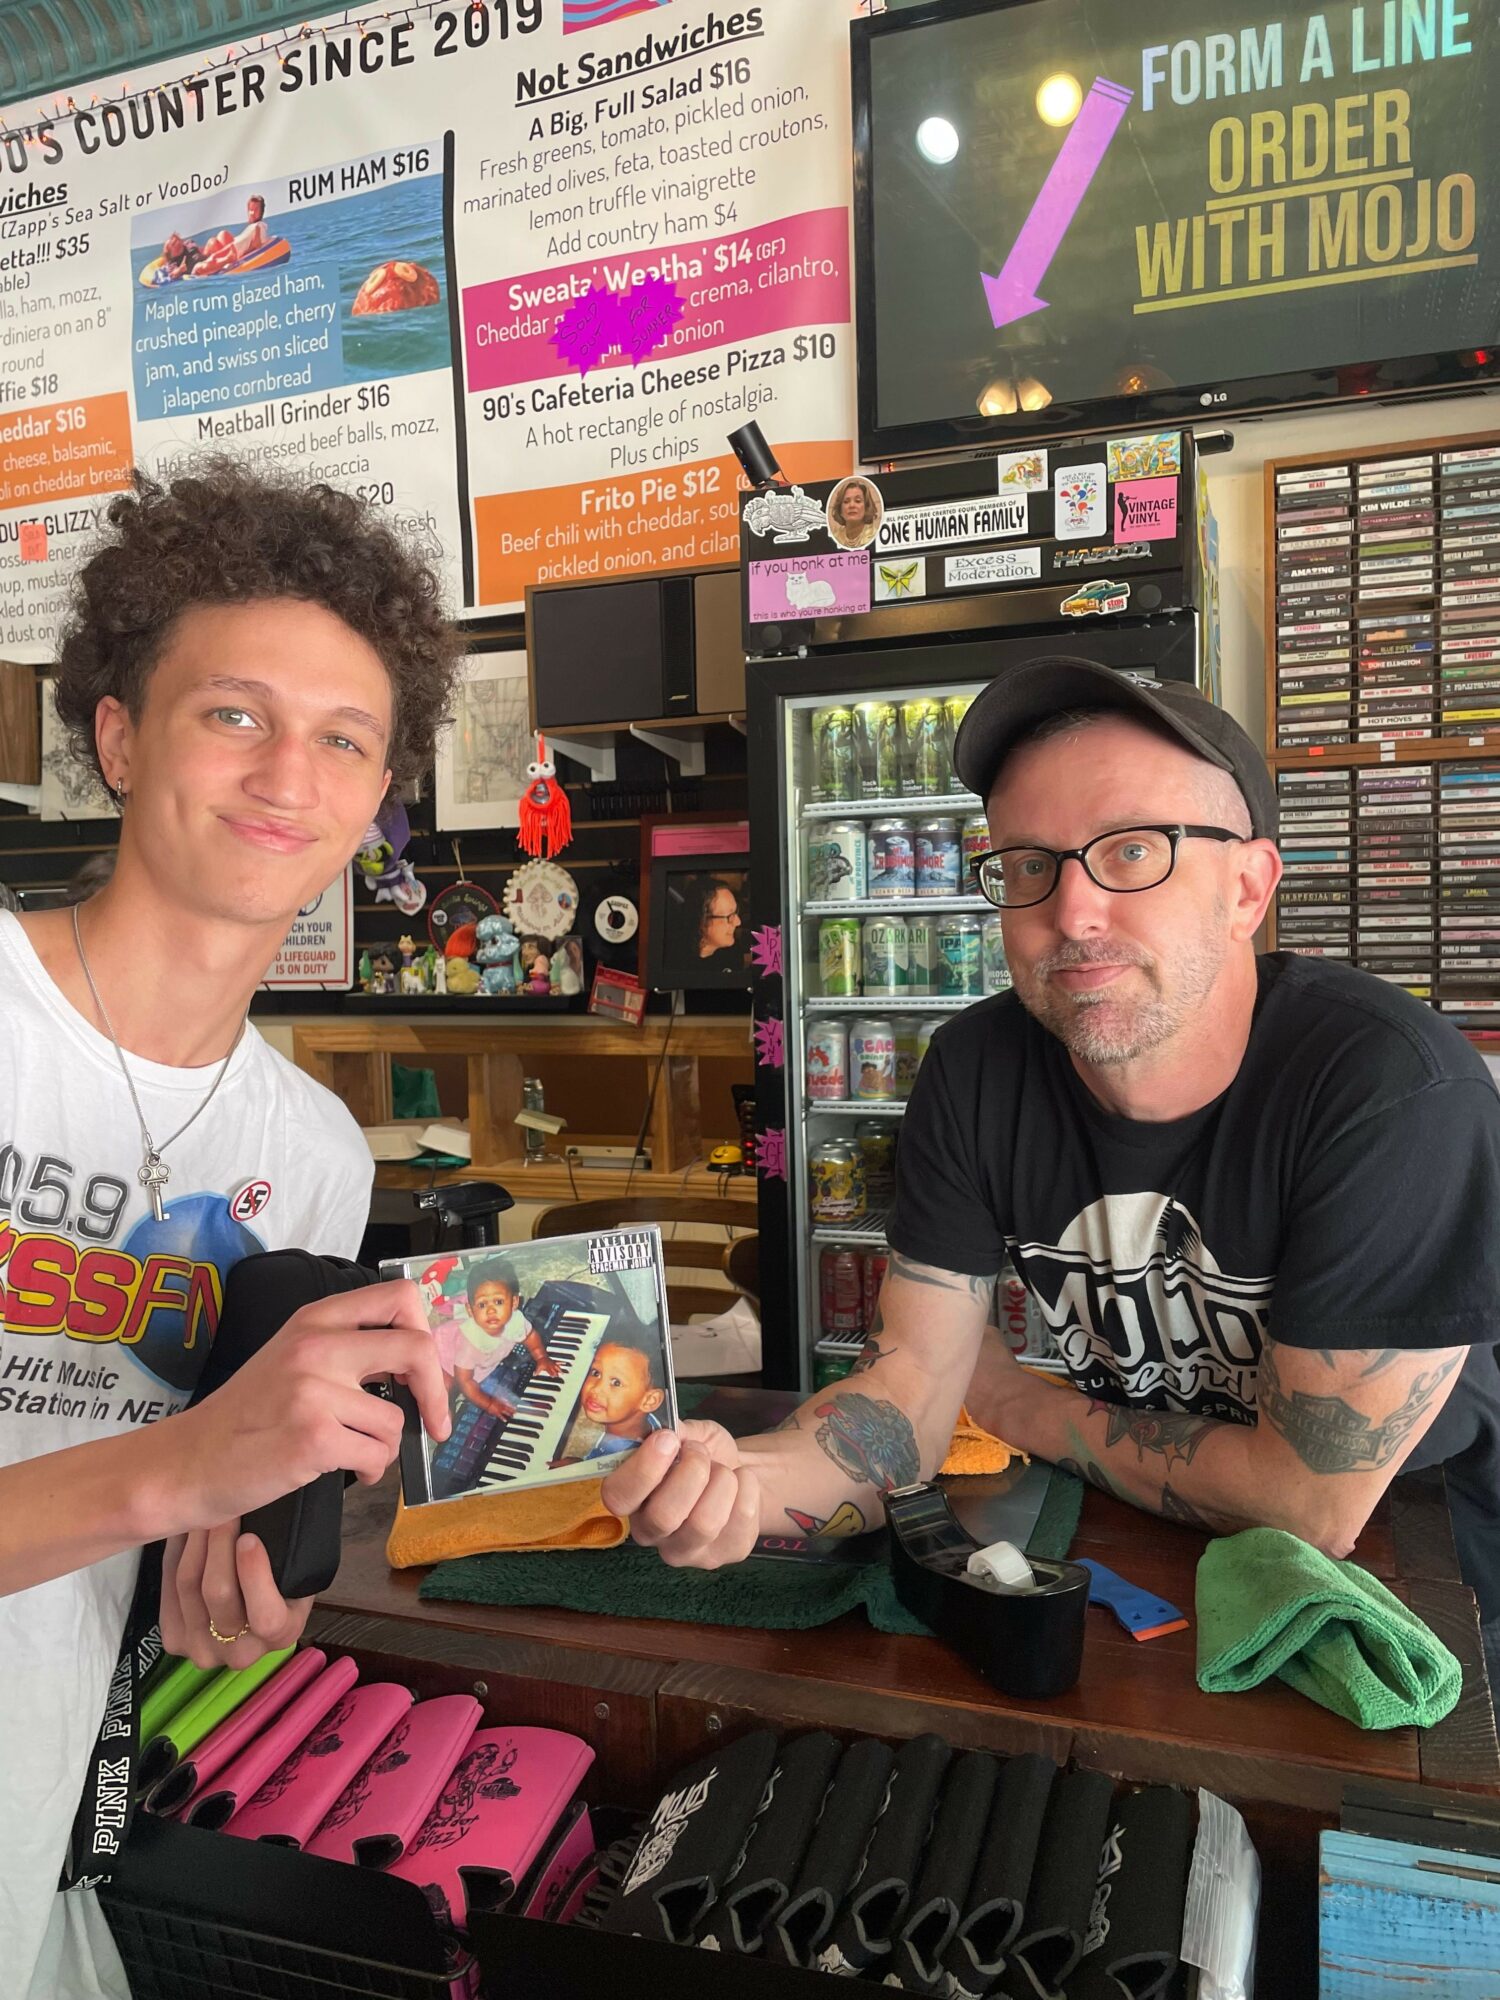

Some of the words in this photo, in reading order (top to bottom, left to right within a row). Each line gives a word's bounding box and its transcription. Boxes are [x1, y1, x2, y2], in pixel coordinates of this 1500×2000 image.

[516, 63, 570, 101] Not
[577, 7, 764, 84] Sandwiches
[1142, 23, 1283, 112] FORM
[1300, 14, 1335, 83] A
[1352, 0, 1473, 74] LINE
[74, 64, 265, 155] COUNTER
[280, 22, 415, 92] SINCE
[434, 0, 542, 57] 2019
[529, 117, 544, 141] A
[551, 109, 589, 136] Big,
[595, 89, 635, 123] Full
[641, 67, 702, 109] Salad
[709, 57, 751, 90] $16
[480, 150, 528, 180] Fresh
[533, 139, 596, 174] greens,
[602, 115, 669, 149] tomato,
[675, 90, 745, 136] pickled
[751, 83, 810, 114] onion,
[1209, 88, 1411, 194] ORDER
[289, 172, 334, 203] RUM
[341, 158, 386, 192] HAM
[392, 148, 430, 178] $16
[463, 174, 552, 214] marinated
[556, 164, 611, 193] olives,
[614, 151, 655, 178] feta,
[659, 130, 732, 166] toasted
[739, 112, 830, 150] croutons,
[1, 211, 59, 239] (Zapp's
[65, 207, 93, 225] Sea
[99, 194, 130, 216] Salt
[136, 193, 152, 207] or
[158, 165, 229, 201] VooDoo)
[529, 203, 583, 230] lemon
[589, 184, 647, 217] truffle
[651, 164, 757, 202] vinaigrette
[55, 233, 90, 259] $35
[547, 231, 582, 259] Add
[587, 217, 659, 251] country
[664, 209, 709, 236] ham
[714, 201, 739, 227] $4
[1135, 202, 1285, 298] WITH
[1308, 172, 1476, 272] MOJO
[508, 266, 598, 311] Sweata'
[714, 238, 753, 272] $14
[756, 237, 786, 262] (GF)
[690, 277, 753, 308] crema,
[758, 258, 840, 290] cilantro,
[145, 296, 188, 323] Maple
[192, 295, 228, 312] rum
[232, 276, 280, 312] glazed
[285, 273, 325, 295] ham,
[135, 323, 198, 353] crushed
[203, 310, 282, 347] pineapple,
[285, 301, 336, 326] cherry
[476, 309, 550, 347] Cheddar
[673, 317, 724, 346] onion
[2, 348, 44, 373] round
[145, 362, 179, 387] jam,
[183, 351, 213, 376] and
[218, 348, 257, 371] swiss
[262, 345, 280, 361] on
[284, 328, 329, 357] sliced
[483, 392, 526, 421] 90's
[531, 377, 635, 413] Cafeteria
[641, 364, 720, 396] Cheese
[726, 346, 786, 377] Pizza
[792, 332, 836, 362] $10
[31, 373, 58, 397] $18
[162, 386, 230, 415] jalapeno
[234, 363, 312, 397] cornbread
[56, 406, 86, 433] $16
[198, 403, 275, 440] Meatball
[281, 392, 351, 425] Grinder
[357, 384, 390, 411] $16
[525, 426, 538, 448] A
[543, 421, 574, 447] hot
[579, 407, 664, 441] rectangle
[668, 399, 688, 424] of
[692, 384, 778, 419] nostalgia.
[310, 426, 343, 451] beef
[348, 420, 387, 445] balls,
[390, 418, 440, 437] mozz,
[610, 445, 647, 469] Plus
[652, 436, 699, 461] chips
[308, 454, 370, 482] focaccia
[581, 486, 635, 516] Frito
[641, 477, 678, 505] Pie
[682, 466, 721, 499] $12
[1128, 498, 1175, 513] VINTAGE
[1360, 503, 1379, 513] KIM
[1380, 499, 1410, 511] WILDE
[44, 508, 102, 536] GLIZZY
[501, 528, 542, 555] Beef
[545, 522, 580, 548] chili
[584, 518, 623, 542] with
[627, 505, 704, 536] cheddar,
[879, 523, 910, 546] ONE
[915, 514, 968, 541] HUMAN
[974, 505, 1026, 533] FAMILY
[1129, 512, 1160, 525] VINYL
[751, 563, 761, 576] if
[764, 562, 788, 577] you
[792, 555, 826, 572] honk
[829, 555, 844, 567] at
[847, 554, 868, 566] me
[948, 562, 1037, 582] Moderation
[955, 553, 1017, 568] Excess
[753, 612, 769, 620] this
[770, 611, 778, 619] is
[780, 610, 797, 618] who
[799, 607, 822, 618] you're
[824, 605, 855, 616] honking
[282, 935, 326, 946] HILDREN
[307, 922, 332, 933] YOUR
[871, 927, 906, 945] OZARK
[940, 937, 962, 950] IPA
[276, 964, 285, 974] IS
[288, 964, 300, 974] ON
[304, 963, 328, 974] DUTY
[284, 950, 336, 962] LIFEGUARD
[587, 1232, 649, 1249] PARENTAL
[590, 1243, 649, 1263] ADVISORY
[591, 1259, 629, 1274] SPACEMAN
[630, 1257, 651, 1269] JOINT
[1006, 1280, 1029, 1355] Coke
[2, 1355, 53, 1383] Hit
[57, 1360, 120, 1390] Music
[0, 1386, 87, 1418] Station
[90, 1396, 110, 1420] in
[117, 1398, 164, 1424] NE
[101, 1652, 132, 1742] PINK
[92, 1756, 130, 1855] PINK
